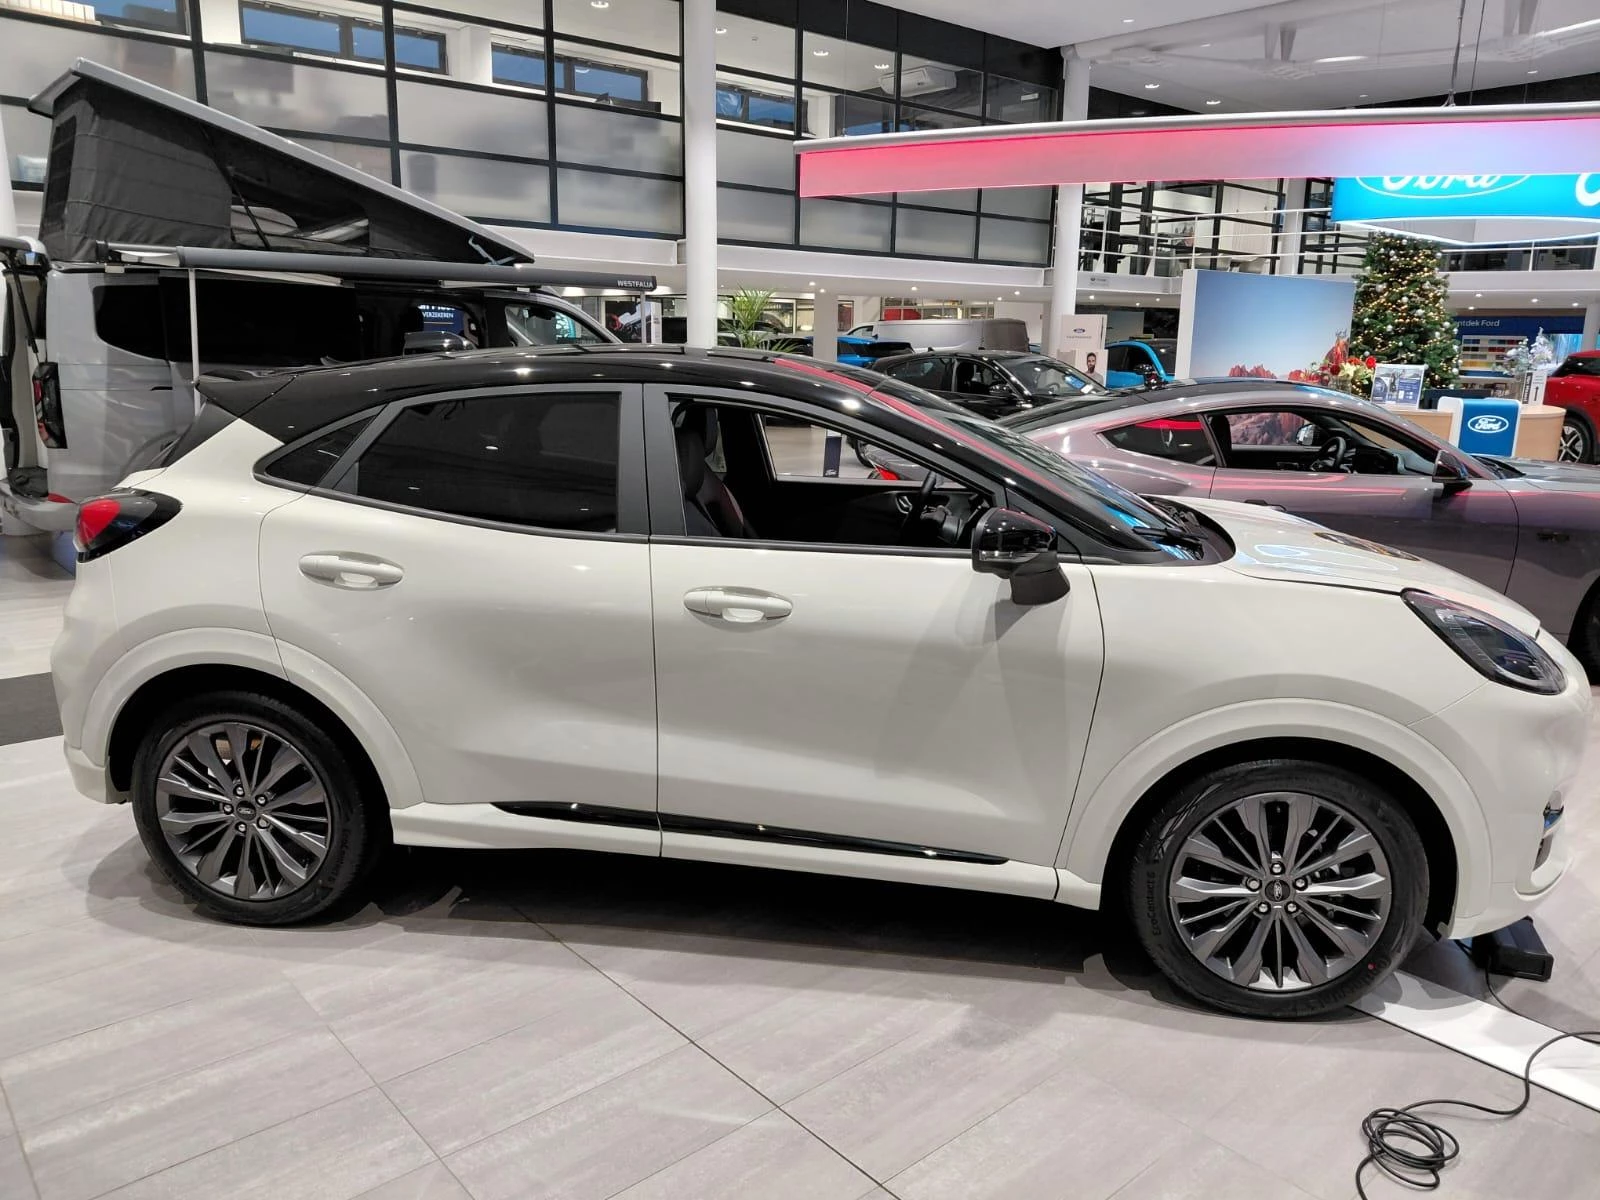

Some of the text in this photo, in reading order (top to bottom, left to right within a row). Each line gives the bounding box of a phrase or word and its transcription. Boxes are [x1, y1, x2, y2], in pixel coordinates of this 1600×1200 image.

[617, 279, 654, 288] WESTFALIA
[1456, 319, 1500, 327] ntdek Ford
[1474, 417, 1502, 430] Ford
